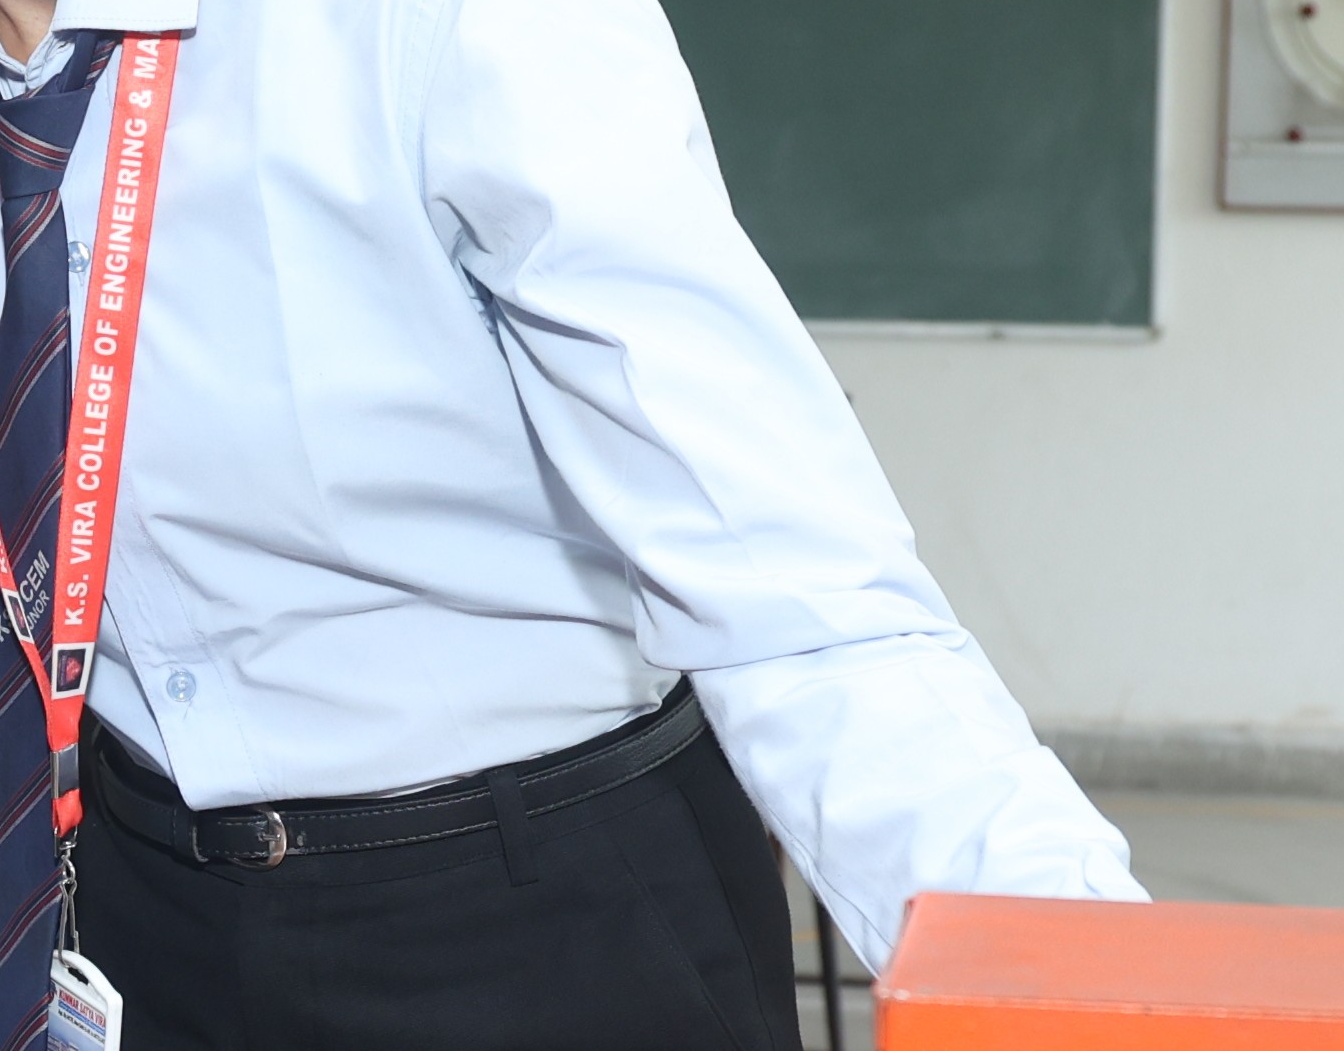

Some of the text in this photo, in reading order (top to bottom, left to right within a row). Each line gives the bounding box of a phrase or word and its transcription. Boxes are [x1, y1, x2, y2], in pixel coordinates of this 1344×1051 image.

[129, 89, 153, 109] &
[99, 119, 147, 311] ENGINEERING
[94, 319, 118, 356] OF
[76, 363, 114, 491] COLLEGE
[70, 500, 97, 565] VIRA
[64, 574, 89, 626] K.S.
